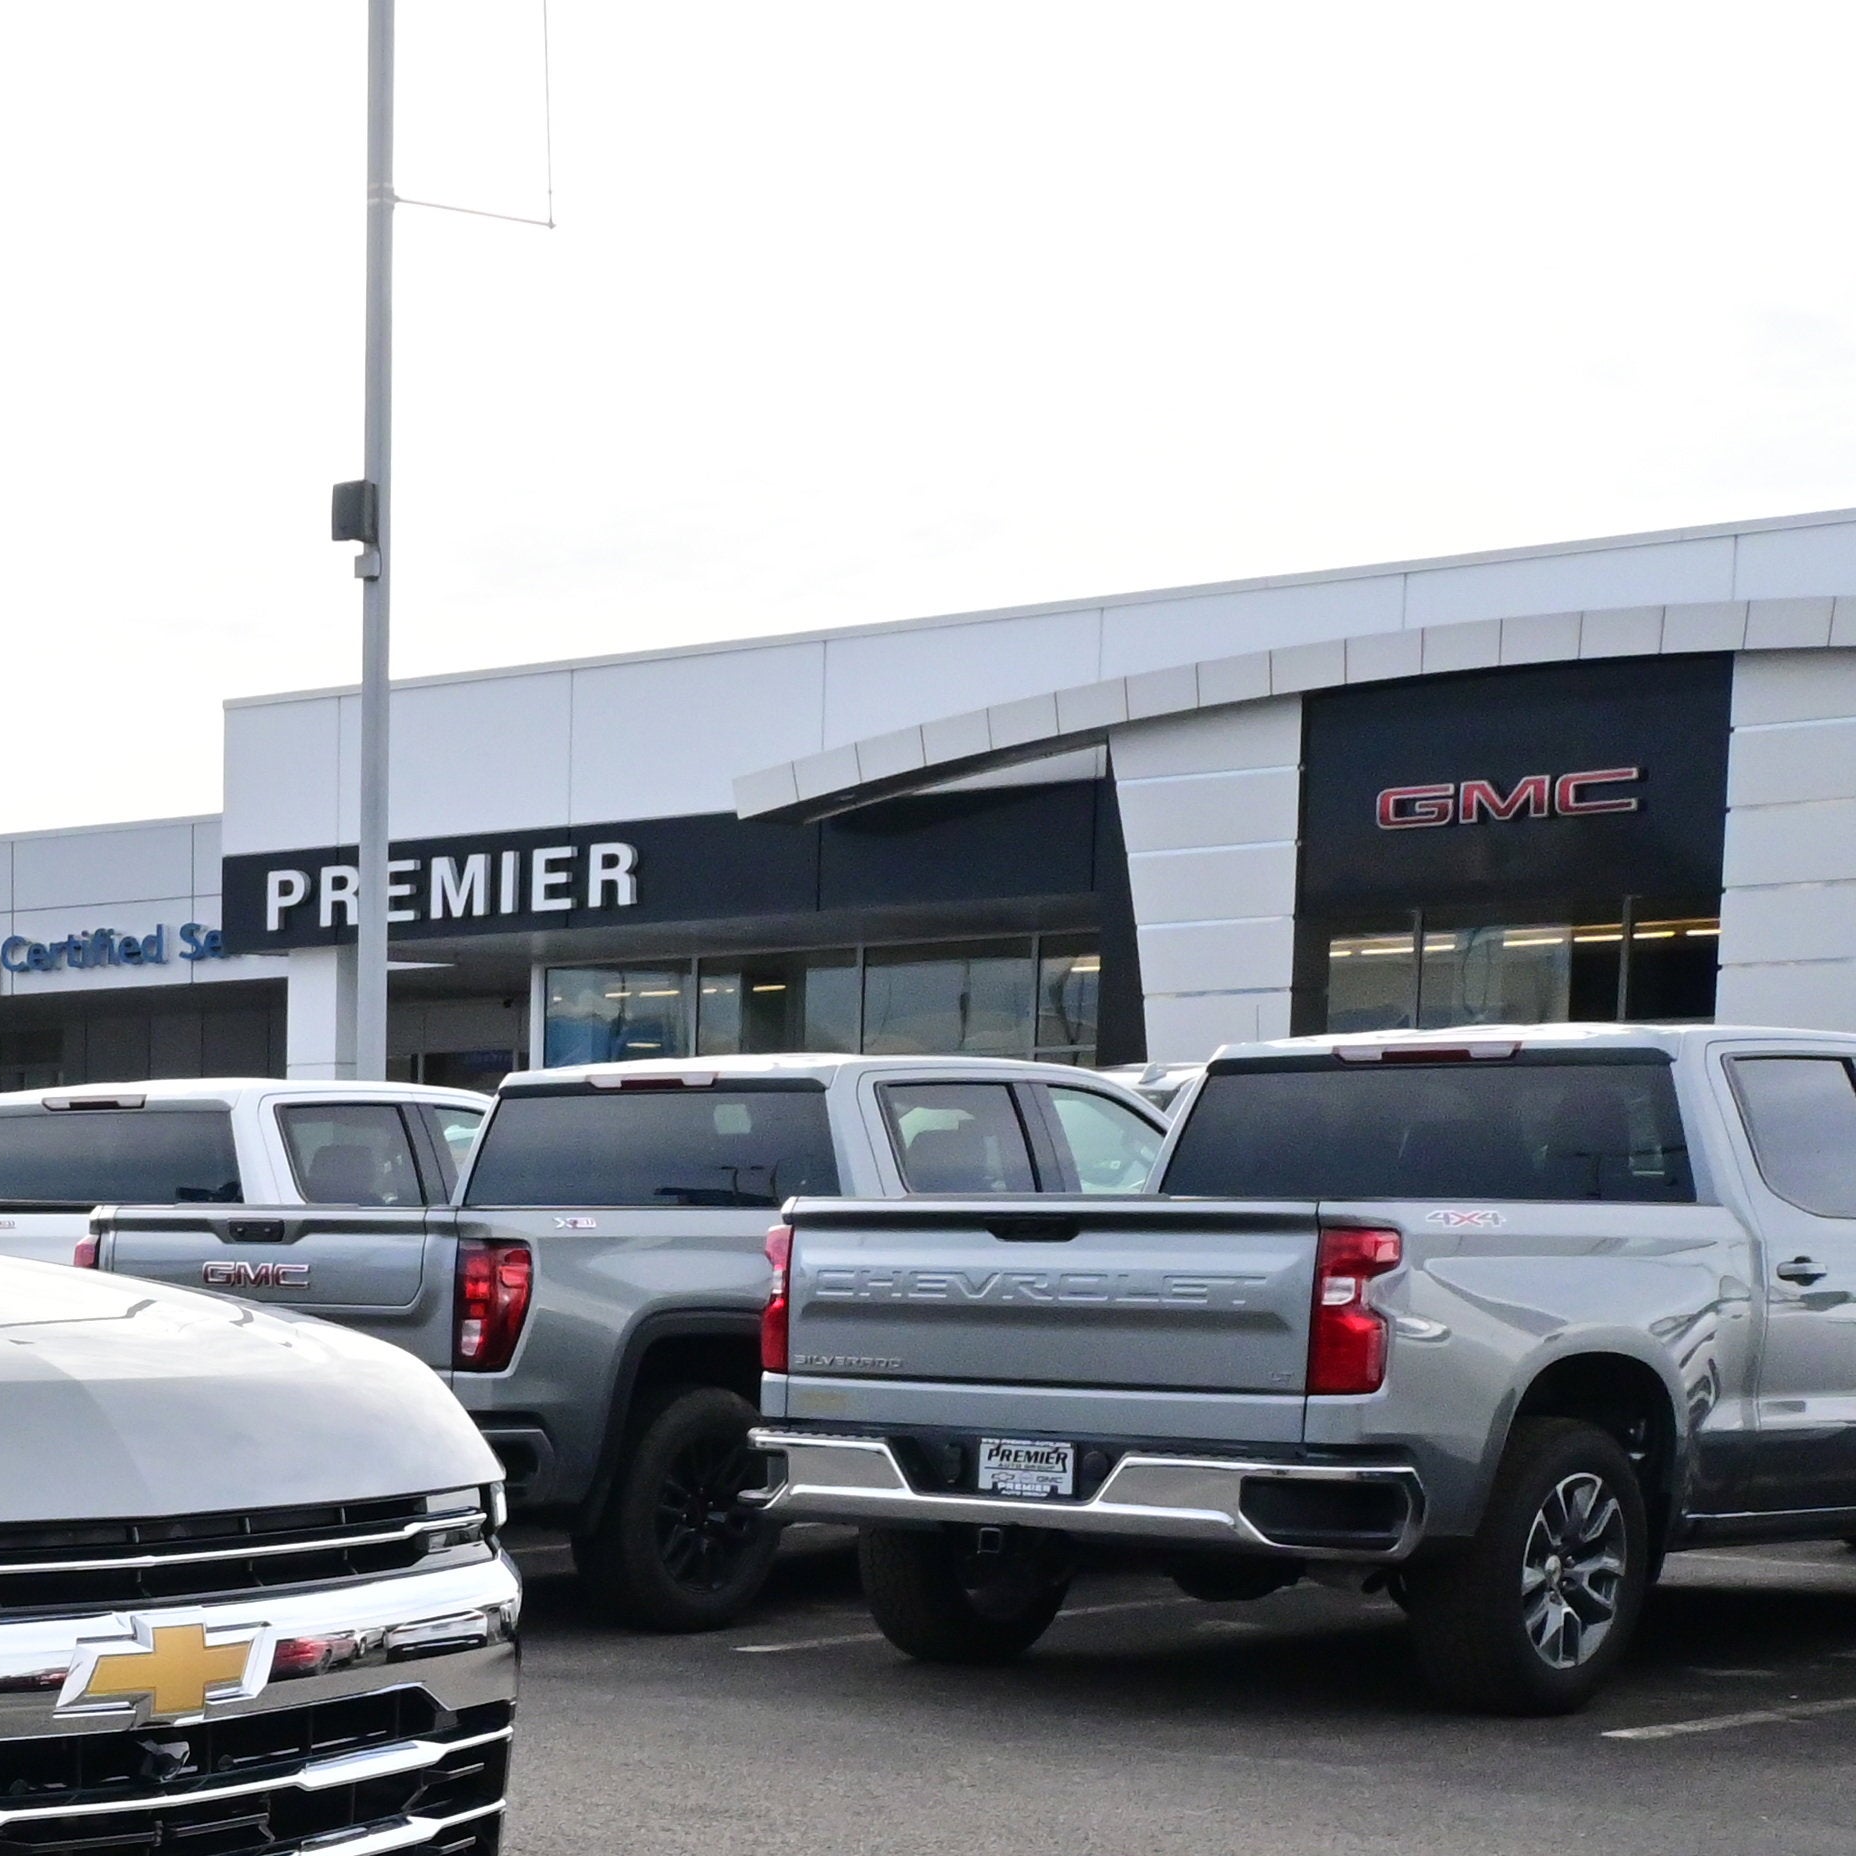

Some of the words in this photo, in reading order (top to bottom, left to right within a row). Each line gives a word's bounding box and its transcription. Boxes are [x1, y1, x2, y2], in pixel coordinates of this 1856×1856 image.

[1376, 767, 1639, 830] GMC
[266, 842, 638, 932] PREMIER
[0, 923, 166, 972] Certified
[202, 1260, 310, 1289] GMC
[816, 1269, 1267, 1305] CHEVROLET
[988, 1446, 1068, 1467] PREMIER
